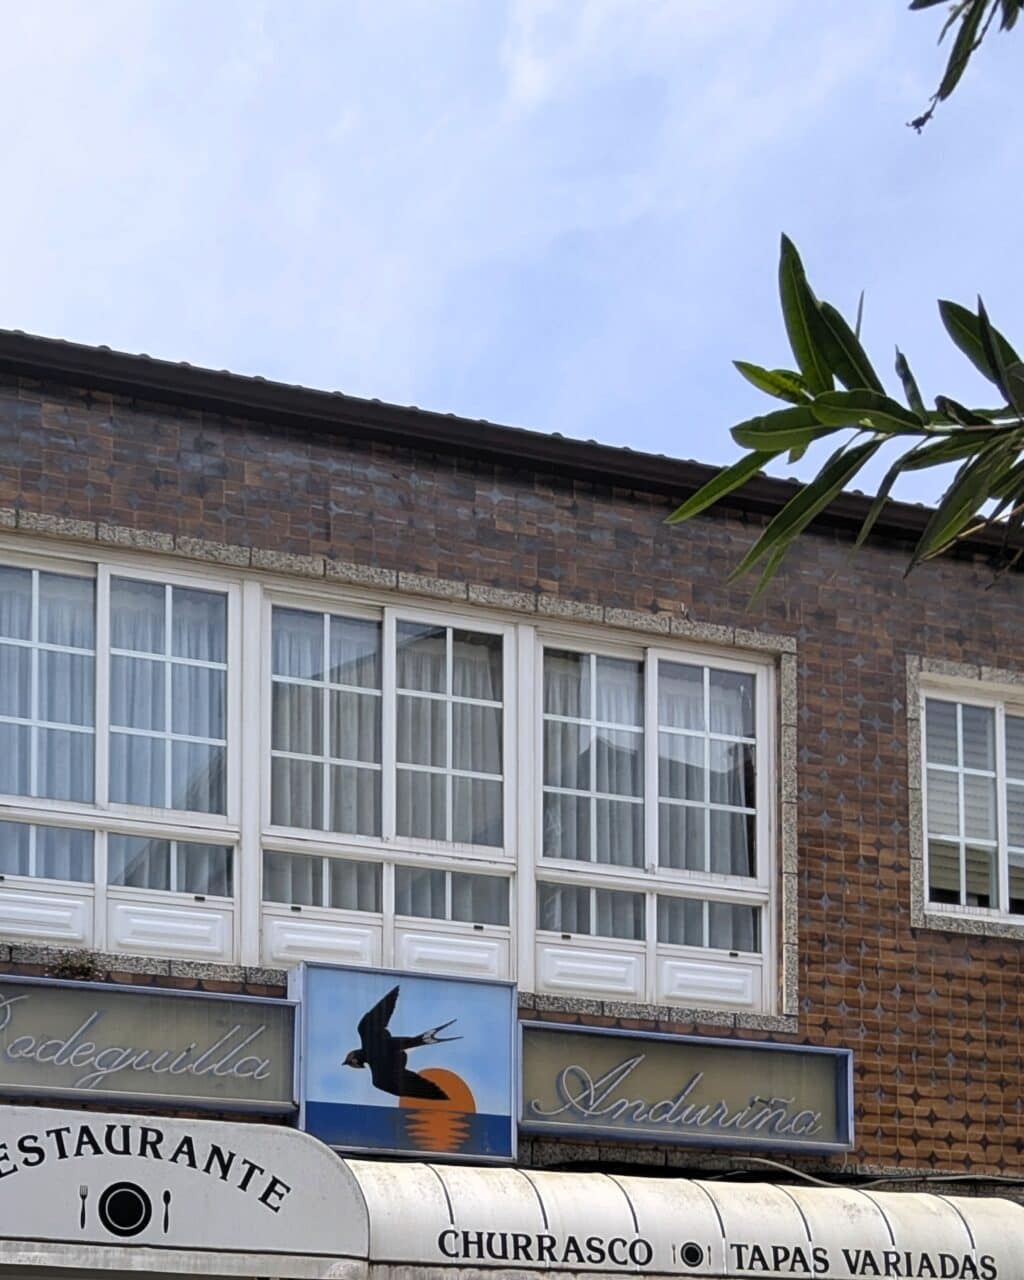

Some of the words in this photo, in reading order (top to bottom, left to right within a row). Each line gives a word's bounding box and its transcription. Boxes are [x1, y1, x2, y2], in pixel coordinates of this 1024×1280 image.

[531, 1053, 825, 1137] Anduriña
[438, 1229, 654, 1267] CHURRASCO
[730, 1242, 831, 1276] TAPAS
[842, 1248, 999, 1280] VARIADAS
